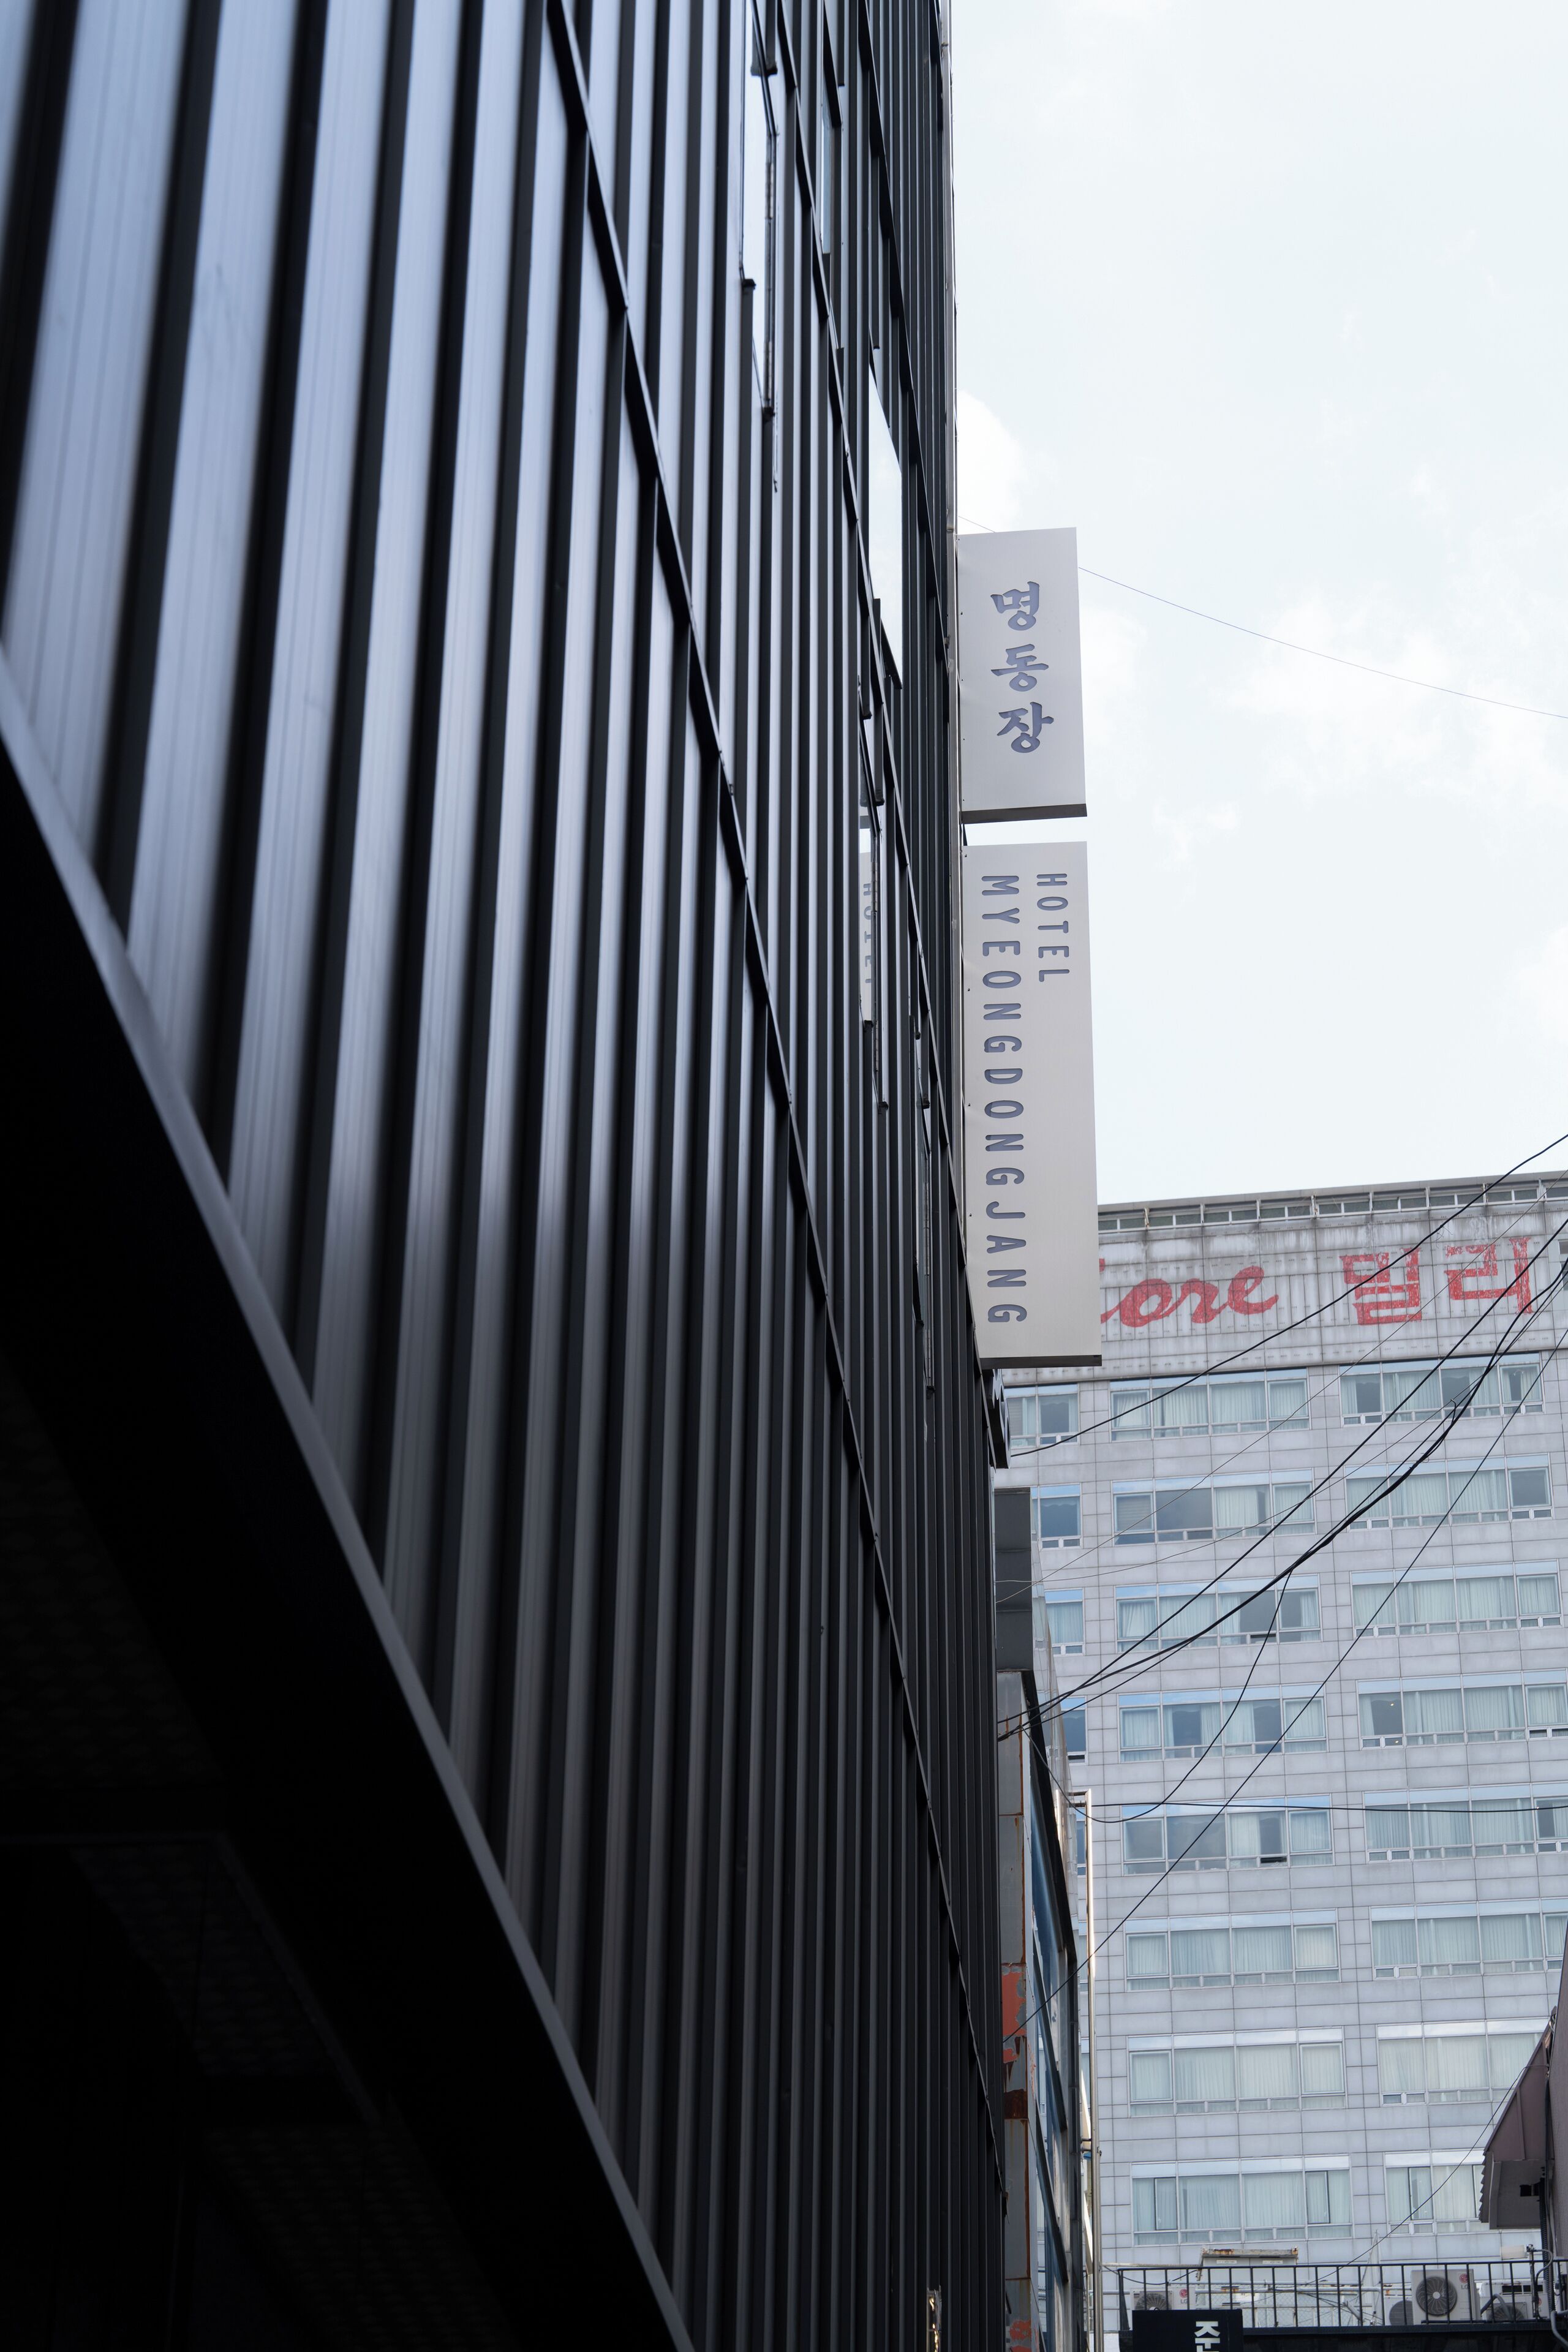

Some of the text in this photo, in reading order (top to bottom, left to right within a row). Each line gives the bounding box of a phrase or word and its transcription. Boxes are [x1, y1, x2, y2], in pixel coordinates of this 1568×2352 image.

[990, 581, 1054, 755] 명동장
[1036, 873, 1070, 982] HOTEL
[981, 875, 1028, 1323] MYEONGDONGJANG
[1099, 1258, 1279, 1328] ore
[1340, 1237, 1533, 1325] 밀리
